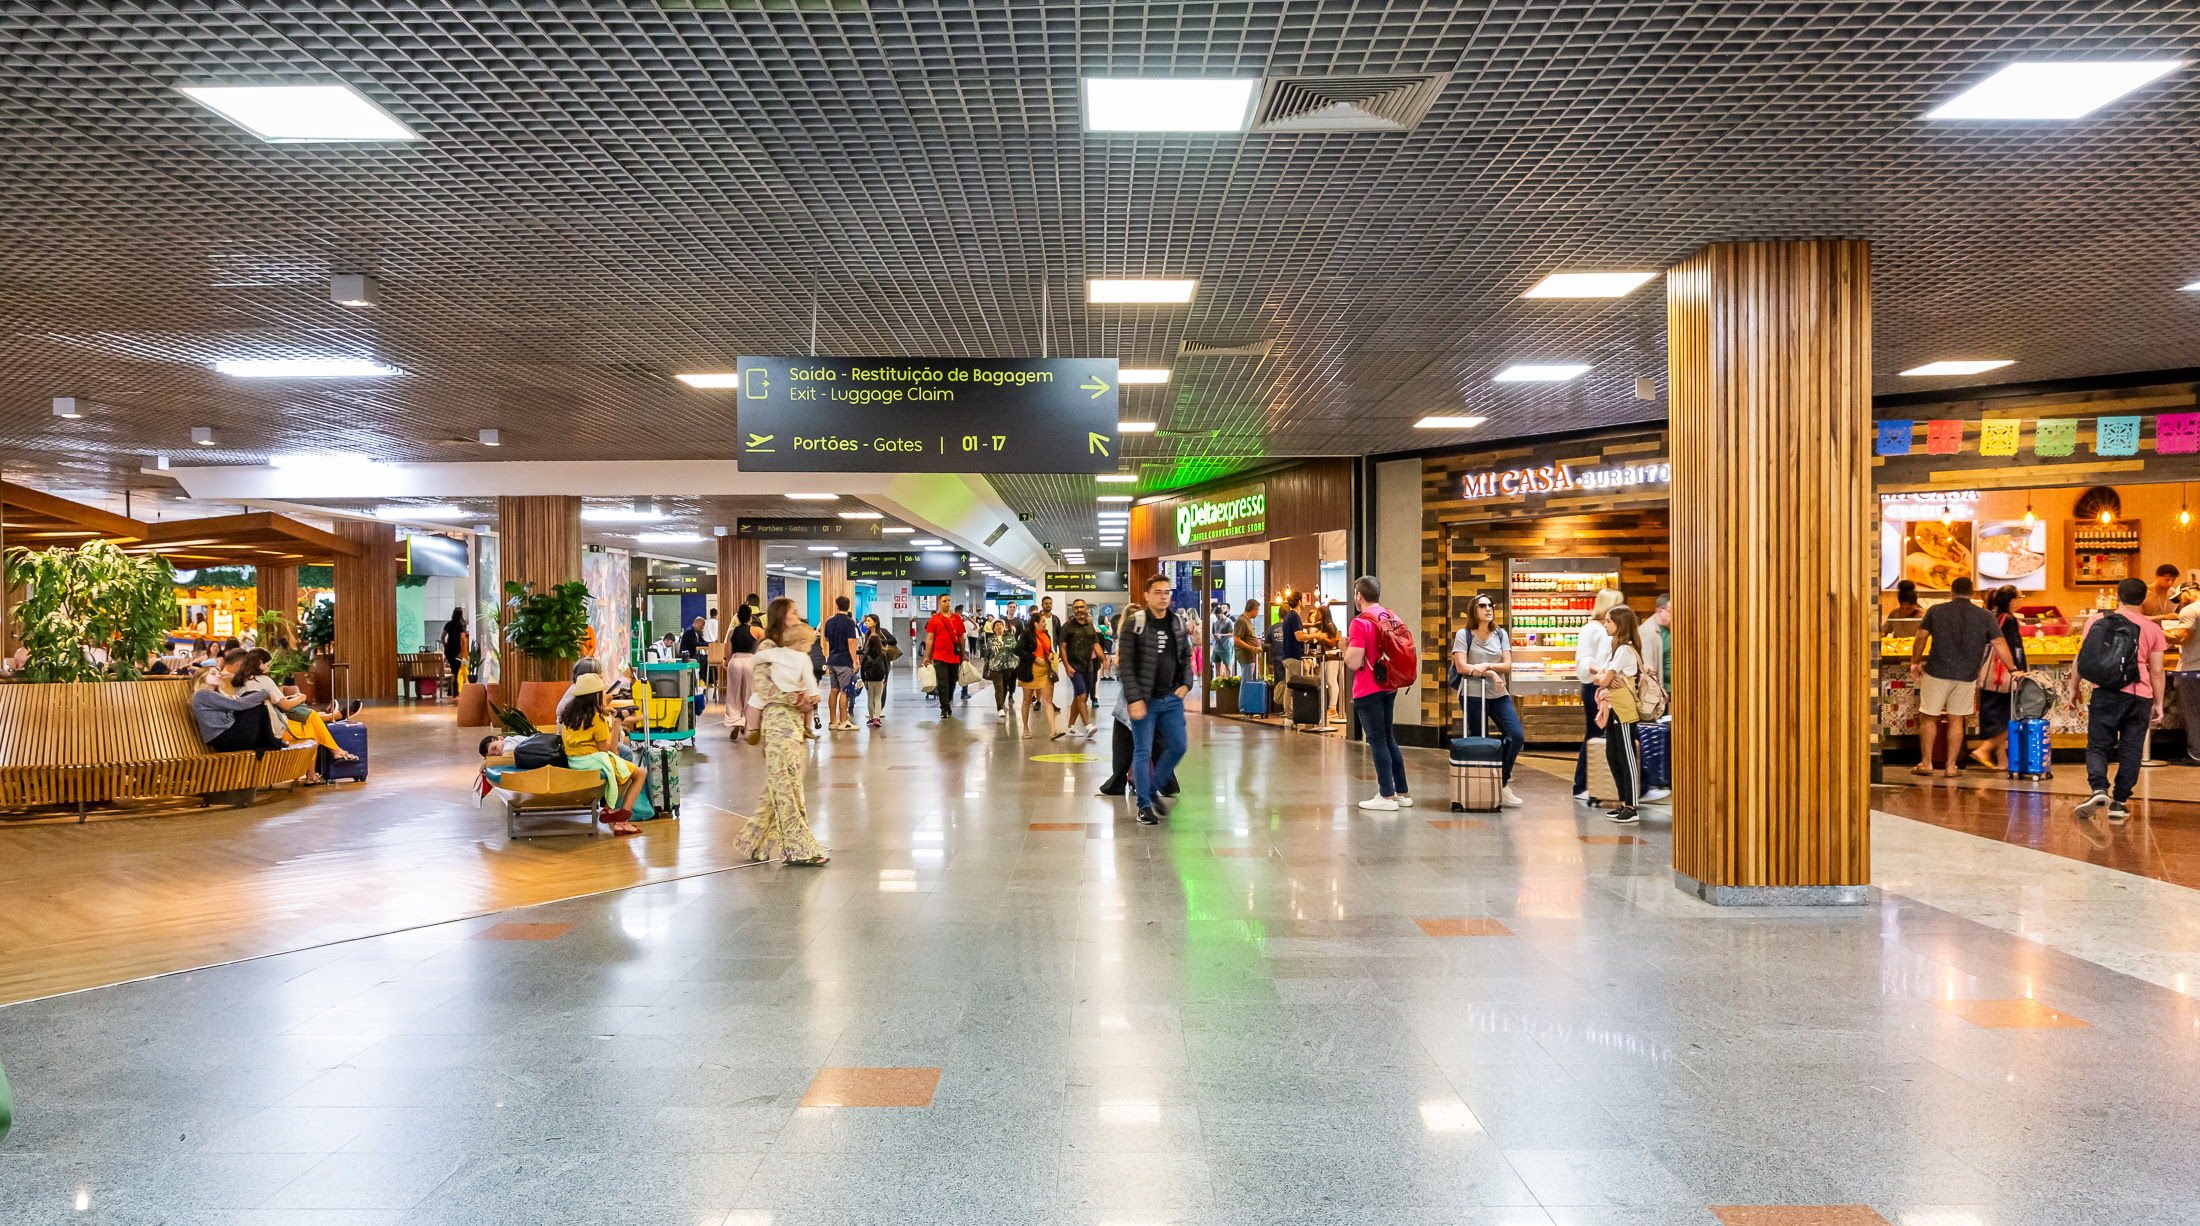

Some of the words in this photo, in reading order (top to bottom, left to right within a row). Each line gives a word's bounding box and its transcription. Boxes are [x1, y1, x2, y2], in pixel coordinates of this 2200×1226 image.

[789, 366, 836, 381] Saída
[852, 366, 943, 385] Restituição
[947, 367, 968, 381] de
[973, 368, 1053, 386] Bagagem
[790, 386, 816, 401] Exit
[831, 387, 902, 405] Luggage
[907, 386, 954, 401] Claim
[793, 436, 858, 451] Portões
[873, 437, 923, 452] Gates
[962, 436, 978, 451] 01
[991, 436, 1006, 451] 17
[1462, 472, 1496, 498] MI
[1499, 465, 1573, 494] CASA
[1190, 494, 1265, 527] Deltaexpresso
[1191, 532, 1208, 542] COFFEE
[1208, 525, 1245, 539] CONVENIENCE
[1247, 522, 1265, 533] STORE
[1214, 578, 1224, 589] 17
